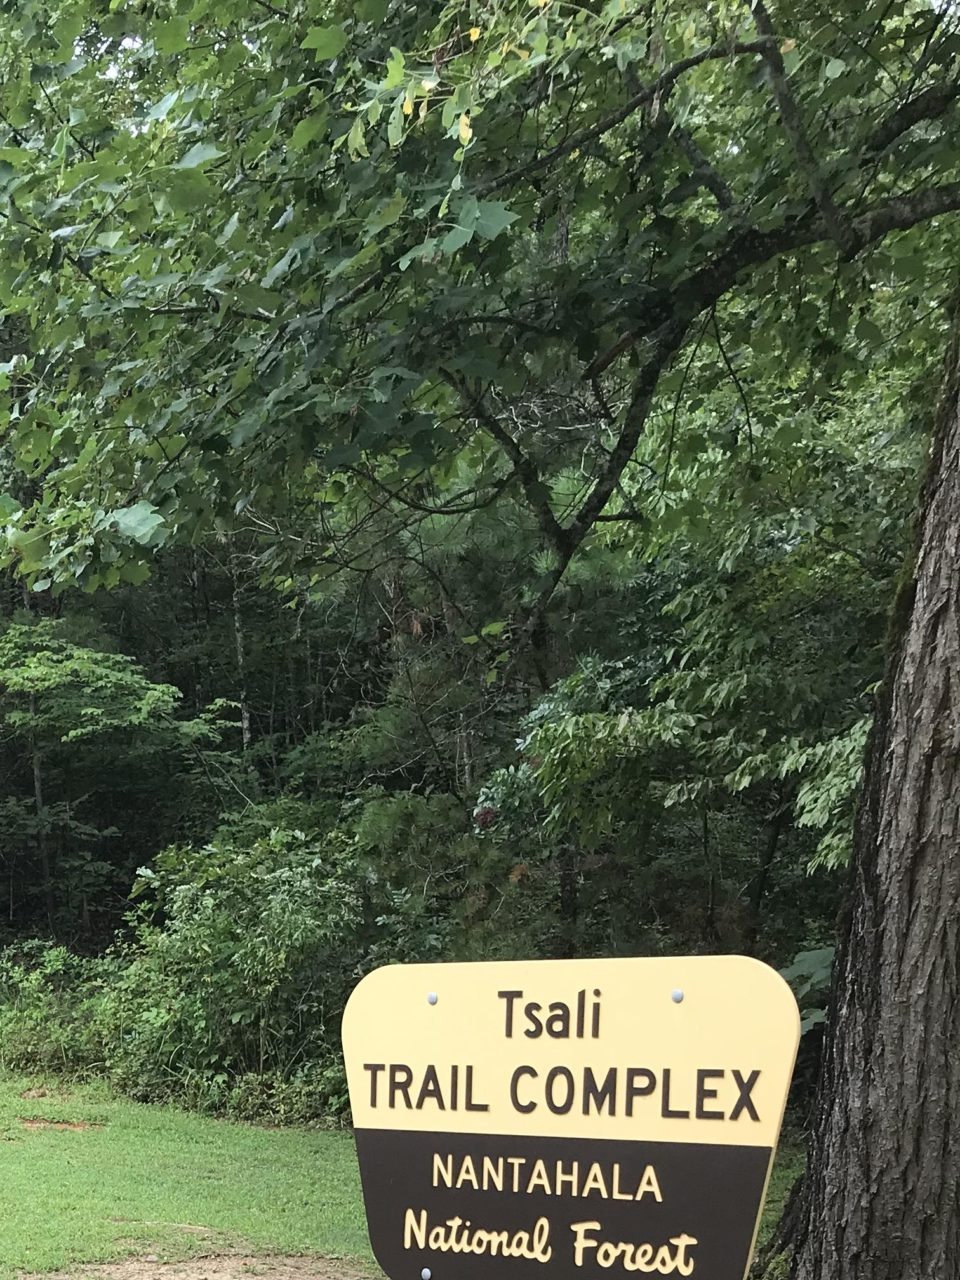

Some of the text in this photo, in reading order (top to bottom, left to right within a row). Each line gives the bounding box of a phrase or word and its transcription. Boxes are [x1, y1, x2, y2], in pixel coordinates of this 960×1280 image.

[497, 988, 601, 1039] Tsali
[362, 1063, 762, 1121] TRAIL COMPLEX
[432, 1152, 663, 1203] NANTAHALA
[403, 1208, 698, 1276] National Forest
